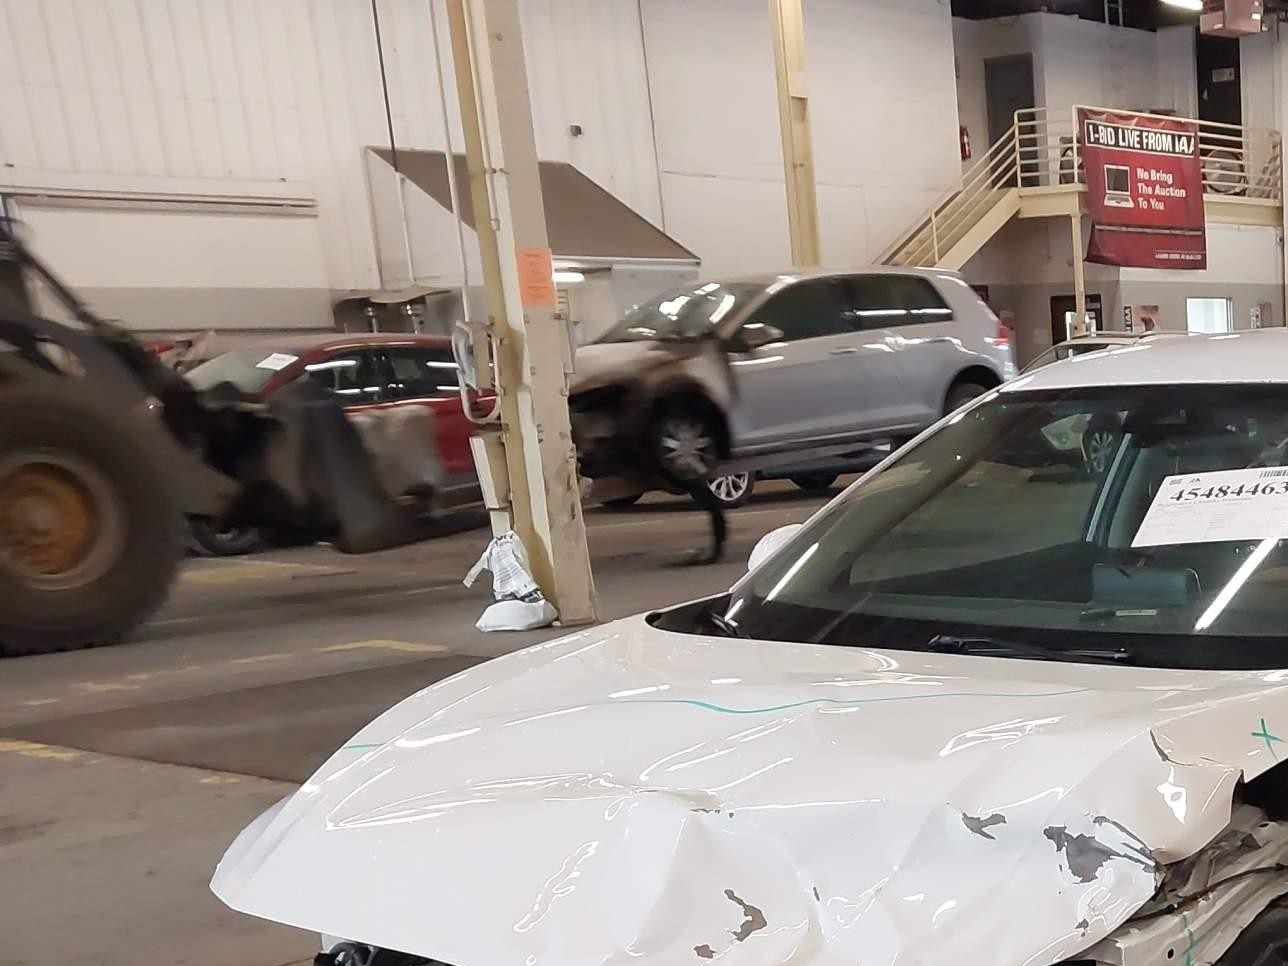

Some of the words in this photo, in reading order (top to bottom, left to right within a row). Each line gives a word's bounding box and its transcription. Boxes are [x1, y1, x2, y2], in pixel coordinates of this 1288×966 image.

[1089, 124, 1116, 145] I-BID
[1118, 127, 1141, 149] LIVE
[1142, 131, 1174, 153] FROM
[1136, 167, 1150, 180] We
[1150, 169, 1173, 185] Bring
[1137, 183, 1153, 195] The
[1154, 184, 1187, 198] Auction
[1138, 198, 1148, 209] To
[1149, 198, 1165, 211] You
